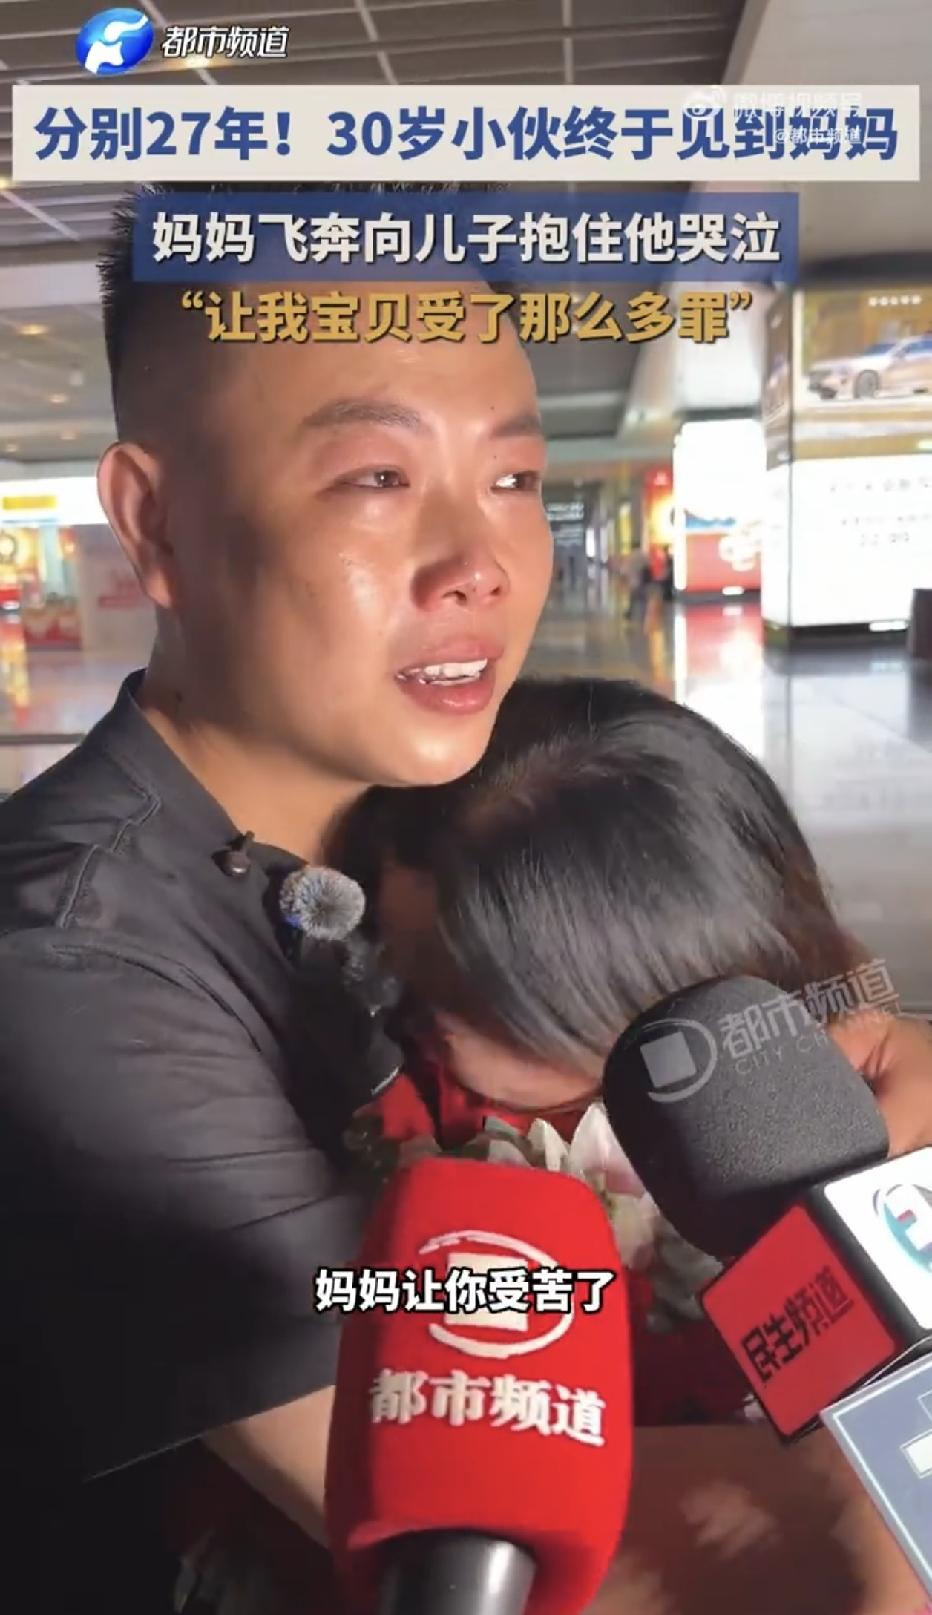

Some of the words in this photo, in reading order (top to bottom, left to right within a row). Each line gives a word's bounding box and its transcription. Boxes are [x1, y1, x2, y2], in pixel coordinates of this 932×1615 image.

[740, 1265, 855, 1384] 民生频道
[368, 1368, 607, 1447] 都市频道
